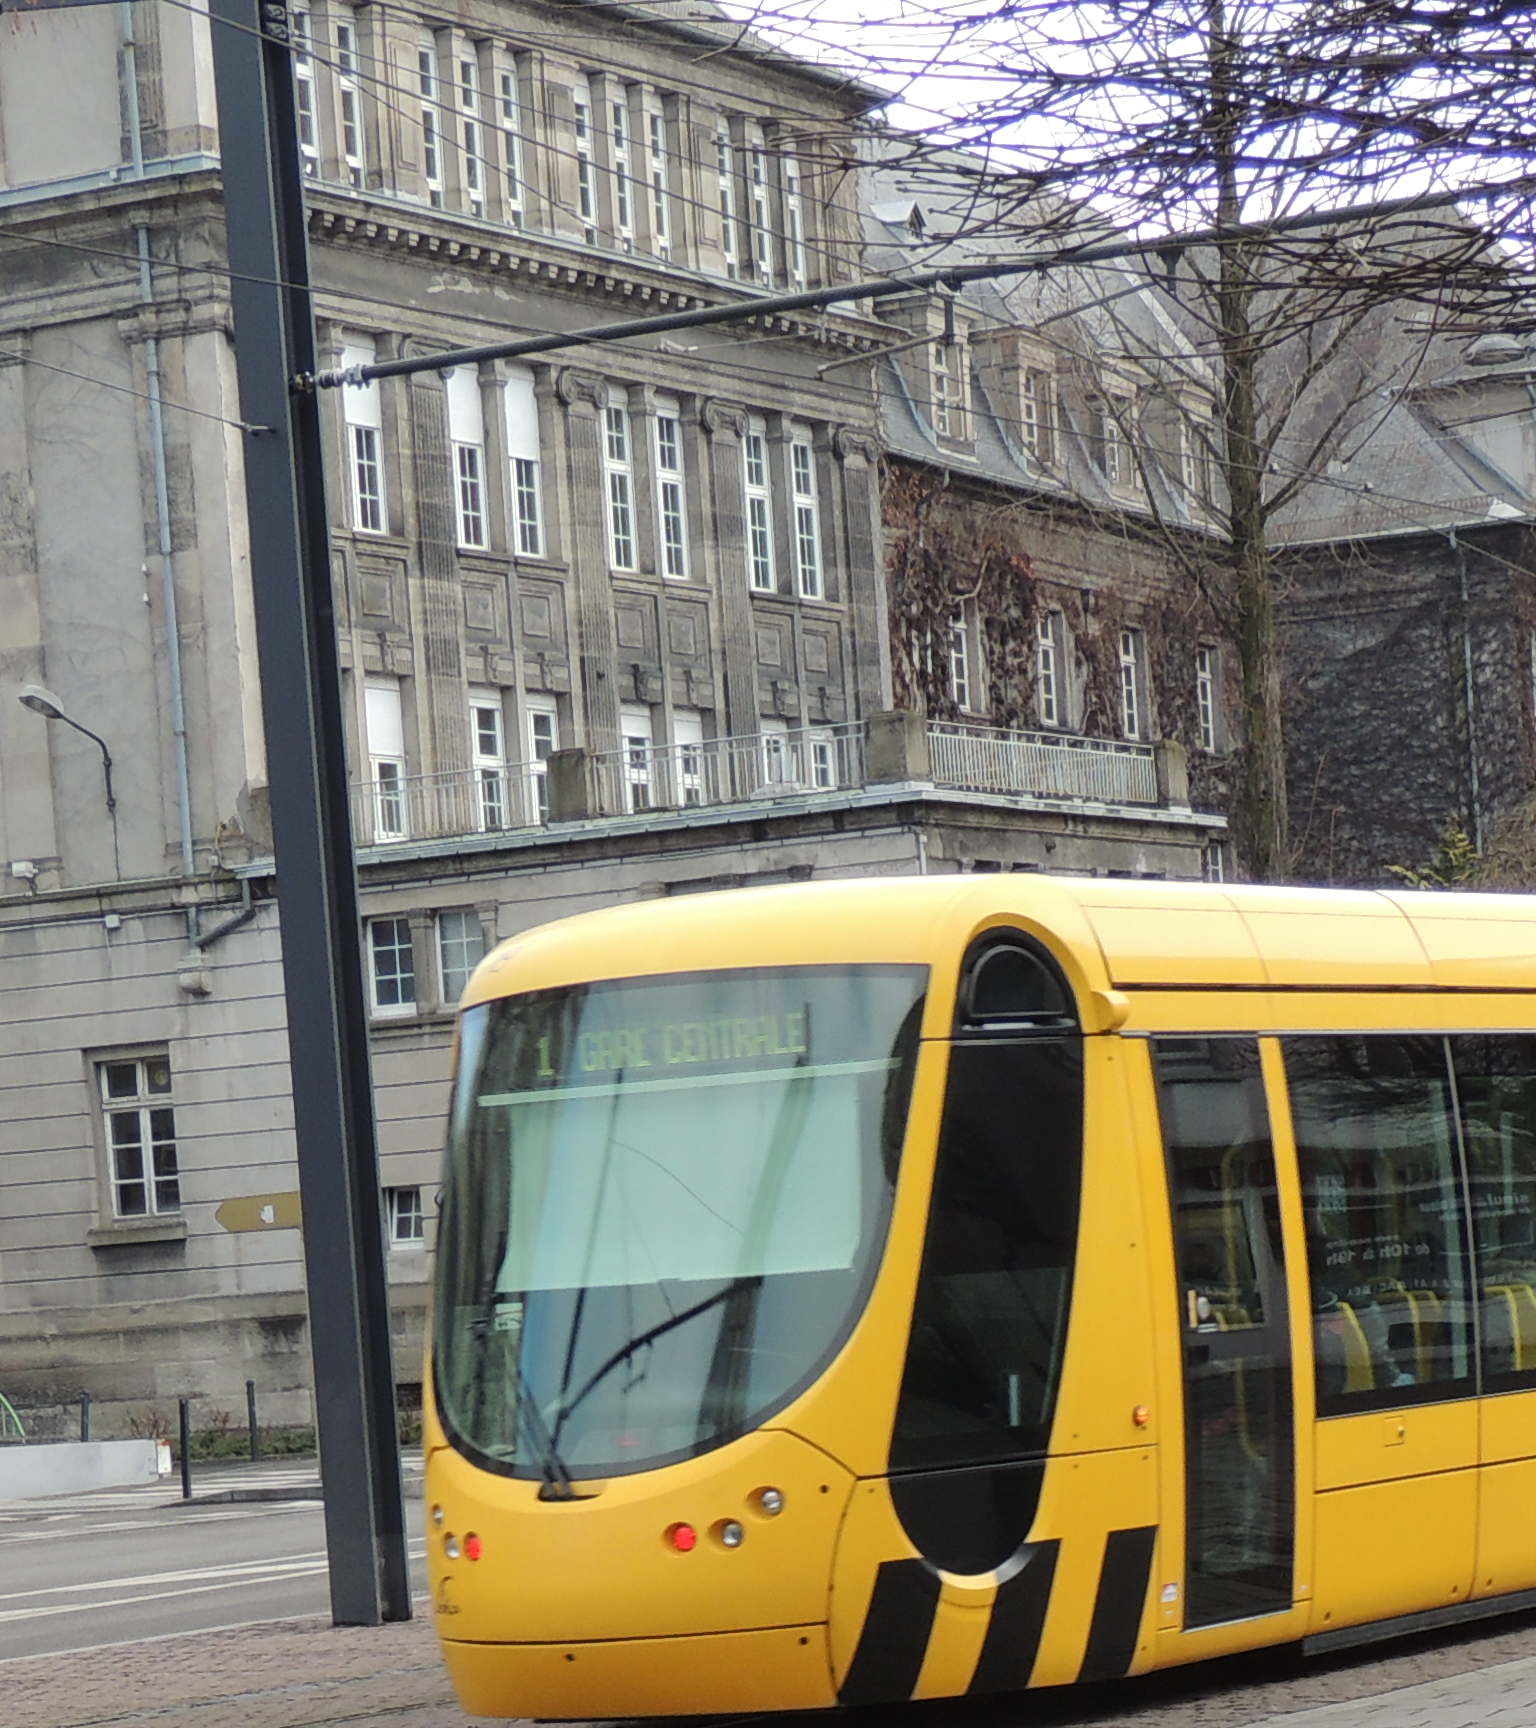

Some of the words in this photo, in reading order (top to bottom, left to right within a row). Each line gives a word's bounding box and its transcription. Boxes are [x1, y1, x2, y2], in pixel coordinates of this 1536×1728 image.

[536, 1035, 556, 1078] 1
[578, 1029, 653, 1072] GARE
[664, 1012, 807, 1064] CENTRALE
